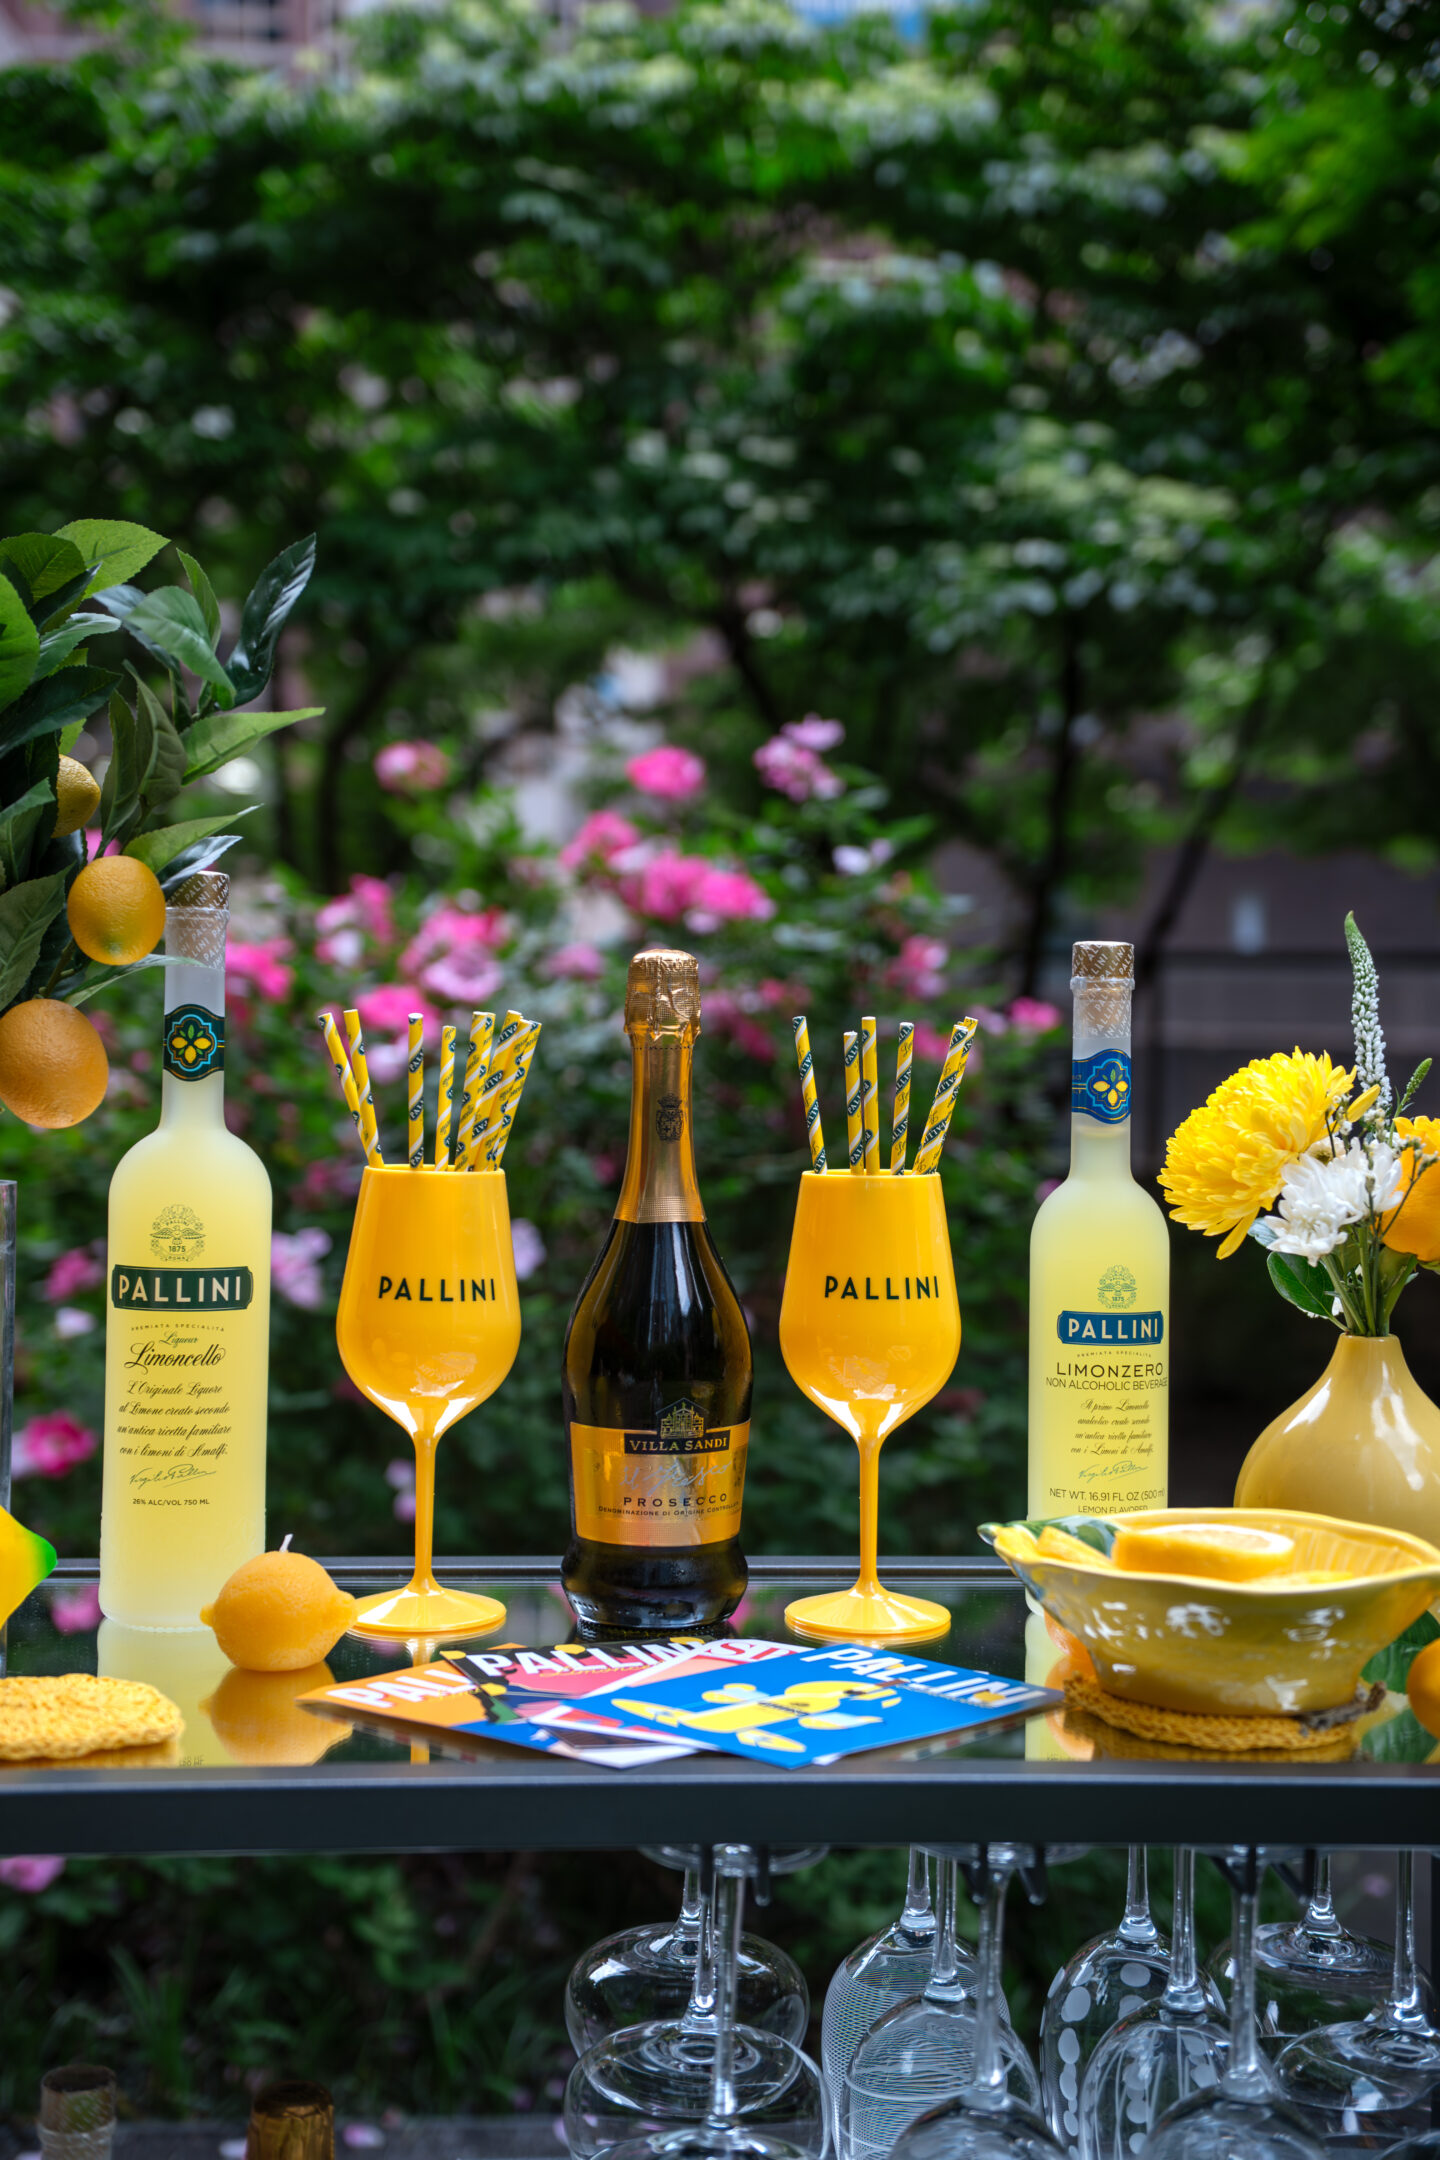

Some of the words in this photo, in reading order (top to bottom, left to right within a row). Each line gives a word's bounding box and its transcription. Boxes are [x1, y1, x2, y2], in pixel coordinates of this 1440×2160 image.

[168, 1245, 187, 1253] 1875
[118, 1274, 241, 1303] PALLINI
[378, 1276, 496, 1302] PALLINI
[824, 1275, 940, 1300] PALLINI
[1068, 1318, 1158, 1339] PALLINI
[123, 1341, 227, 1375] Limoncello
[1056, 1362, 1163, 1378] LIMONZERO
[1046, 1376, 1067, 1388] NON
[1068, 1380, 1131, 1391] ALCOHOLIC
[194, 1401, 230, 1416] secondo
[185, 1423, 232, 1441] familiare
[629, 1439, 680, 1452] VILLA
[684, 1437, 728, 1451] SANDI
[133, 1498, 146, 1506] 26%
[148, 1499, 182, 1507] ALC/VOL
[183, 1499, 197, 1507] 750
[199, 1498, 211, 1506] ML
[623, 1493, 727, 1508] PROSECCO
[1049, 1488, 1067, 1498] NET
[1069, 1490, 1087, 1501] WT.
[1088, 1491, 1110, 1502] 16.91
[1112, 1492, 1125, 1502] FL
[1126, 1491, 1140, 1502] OZ
[1077, 1505, 1108, 1514] LEMON
[800, 1648, 1047, 1708] PALLINI
[326, 1669, 478, 1708] PALL
